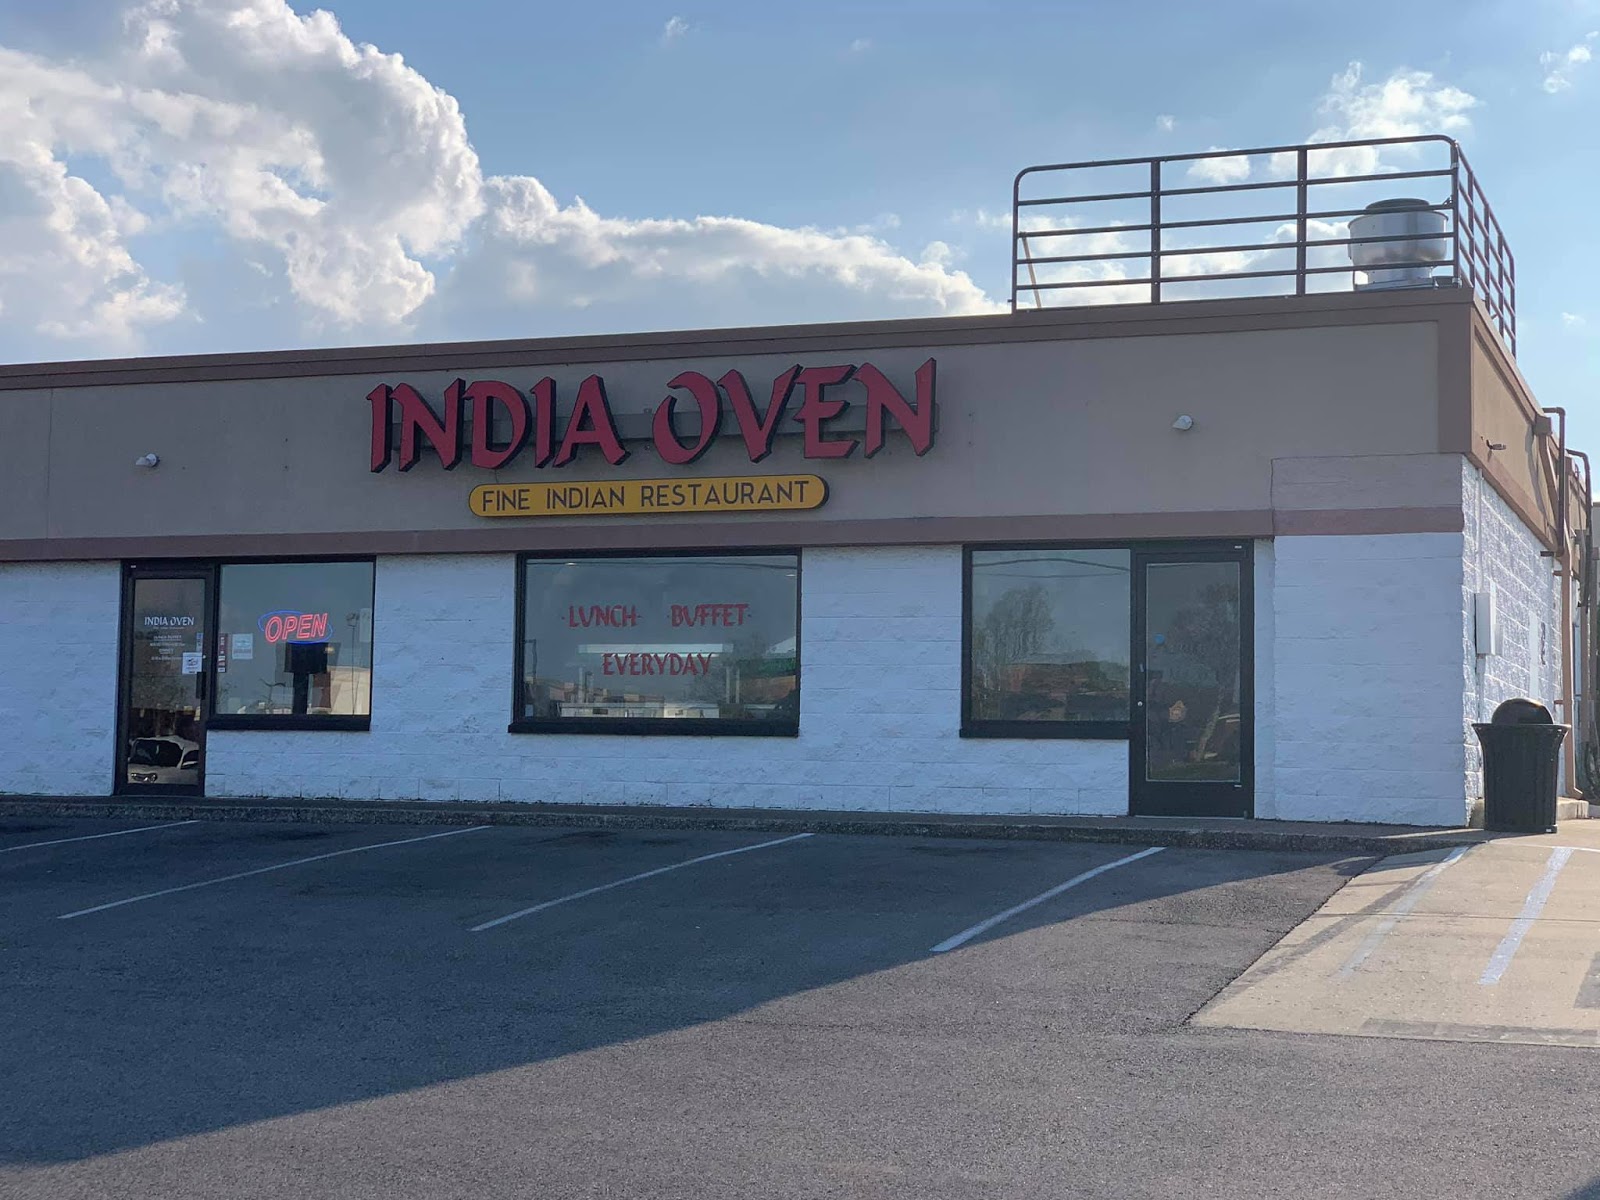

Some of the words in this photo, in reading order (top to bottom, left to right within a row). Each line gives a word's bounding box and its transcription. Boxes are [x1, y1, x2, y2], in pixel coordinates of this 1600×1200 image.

[366, 375, 629, 473] INDIA
[652, 358, 936, 464] OVEN
[482, 489, 530, 512] FINE
[546, 486, 625, 510] INDIAN
[640, 480, 809, 507] RESTAURANT
[144, 616, 168, 626] INDIA
[170, 616, 195, 626] OVEN
[265, 613, 328, 643] OPEN
[568, 604, 637, 628] LUNCH
[670, 603, 749, 627] BUFFET
[602, 652, 714, 676] EVERYDAY
